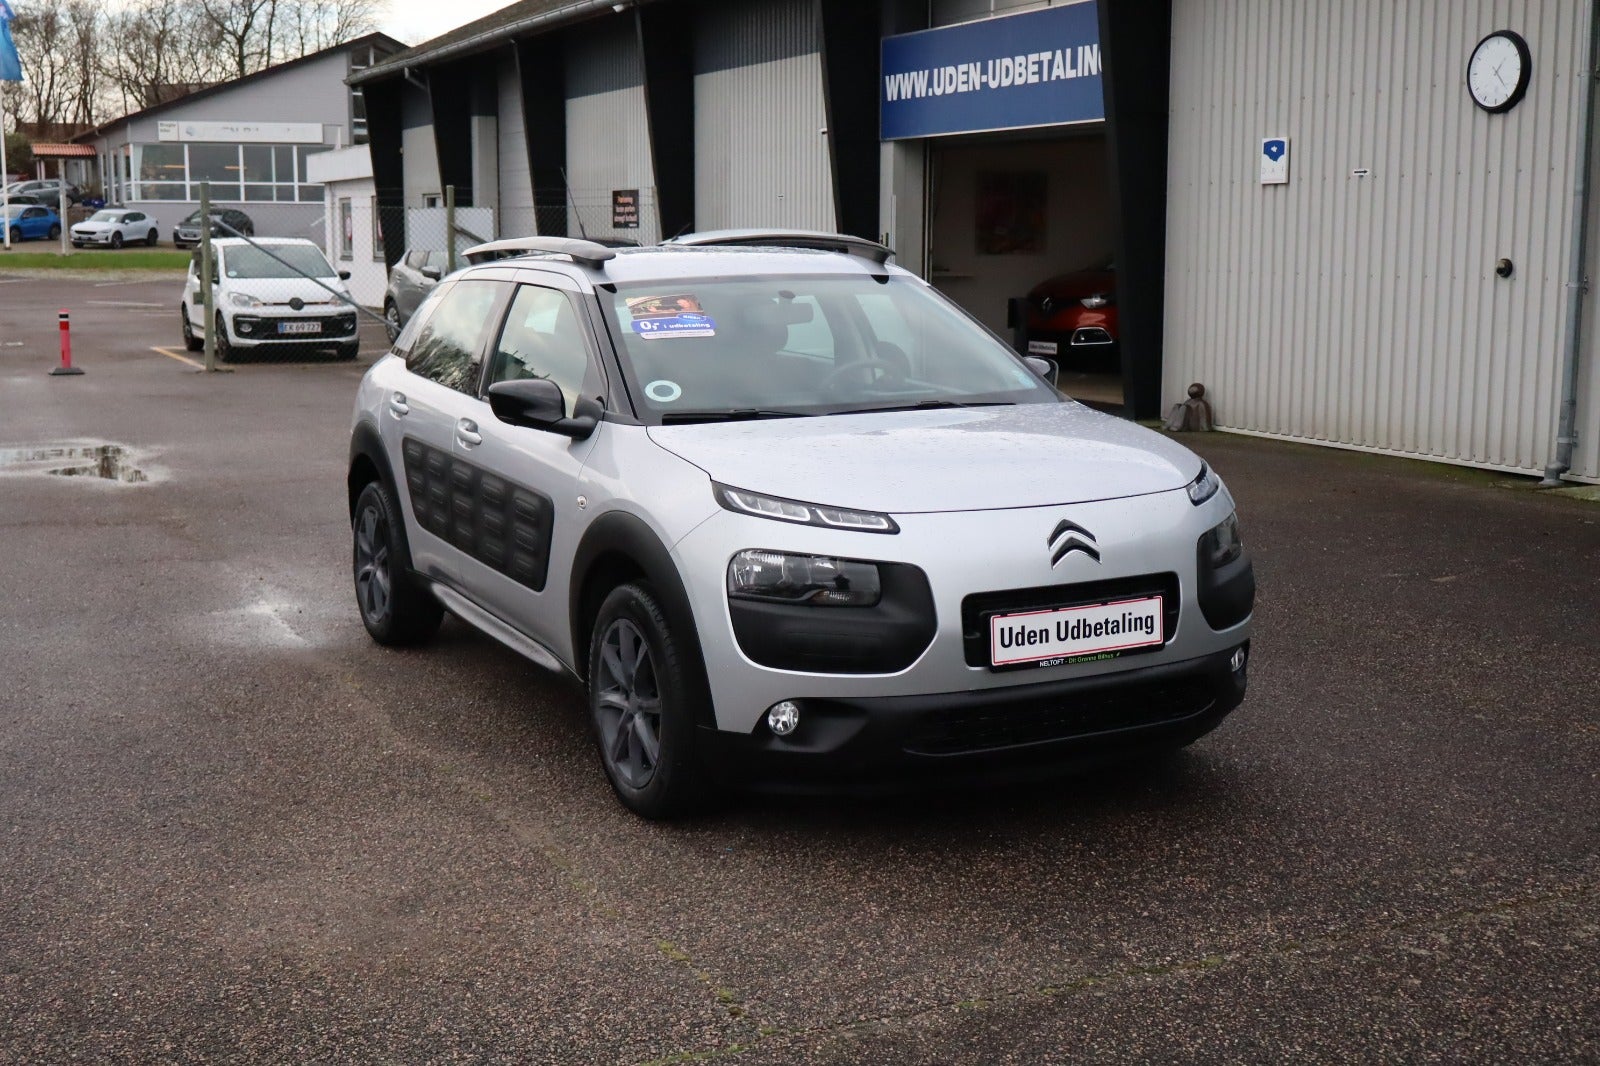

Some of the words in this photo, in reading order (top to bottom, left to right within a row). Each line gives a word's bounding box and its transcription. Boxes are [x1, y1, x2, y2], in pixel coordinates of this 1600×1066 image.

[885, 43, 1102, 101] WWW.UDEN-UDBETALIN
[1000, 625, 1050, 649] Uden
[1056, 612, 1155, 642] Udbetaling
[1039, 658, 1065, 668] NELTOFT
